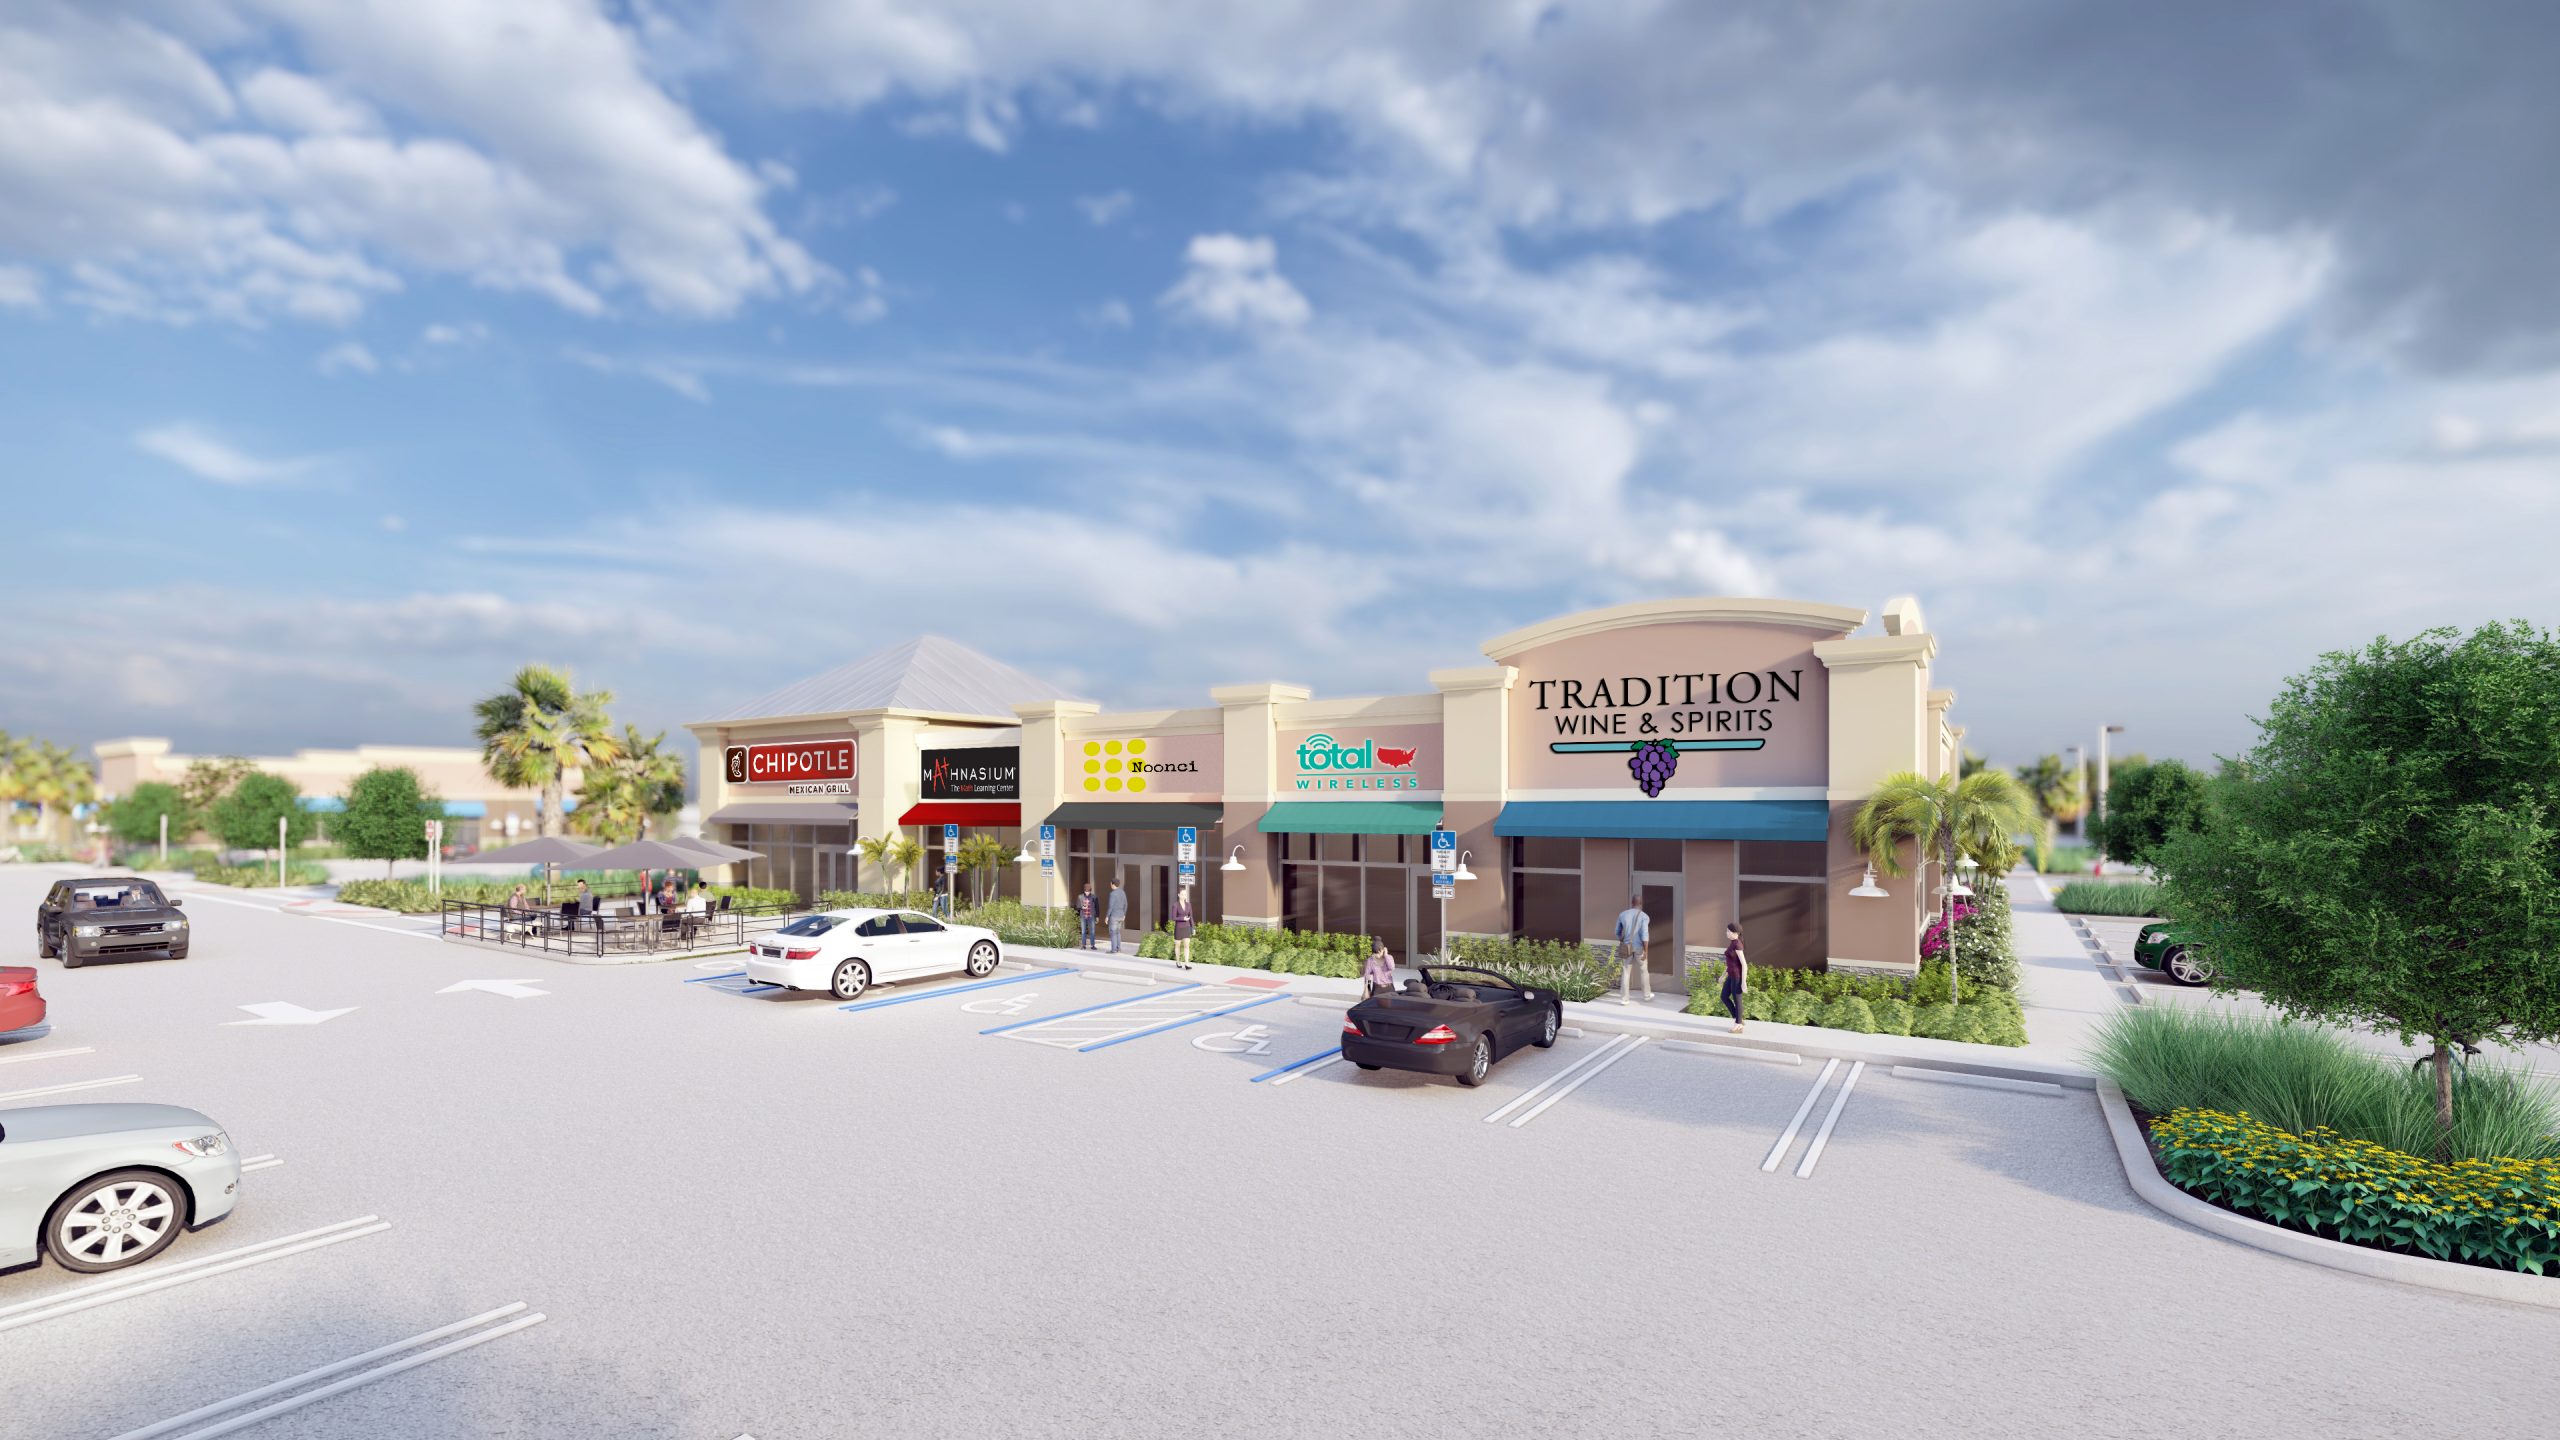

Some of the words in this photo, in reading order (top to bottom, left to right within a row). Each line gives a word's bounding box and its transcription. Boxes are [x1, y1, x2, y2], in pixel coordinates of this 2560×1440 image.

[1529, 669, 1804, 710] TRADITION
[1555, 713, 1627, 735] WINE
[1639, 712, 1659, 734] &
[1670, 709, 1773, 733] SPIRITS
[752, 748, 849, 773] CHIPOTLE
[1296, 739, 1372, 770] total
[1131, 760, 1199, 773] Noonci
[789, 785, 824, 794] MEXICAN
[826, 784, 849, 793] GRILL
[950, 784, 960, 792] The
[974, 784, 996, 795] Learning
[996, 784, 1014, 792] Center
[1296, 777, 1417, 790] WIRELESS
